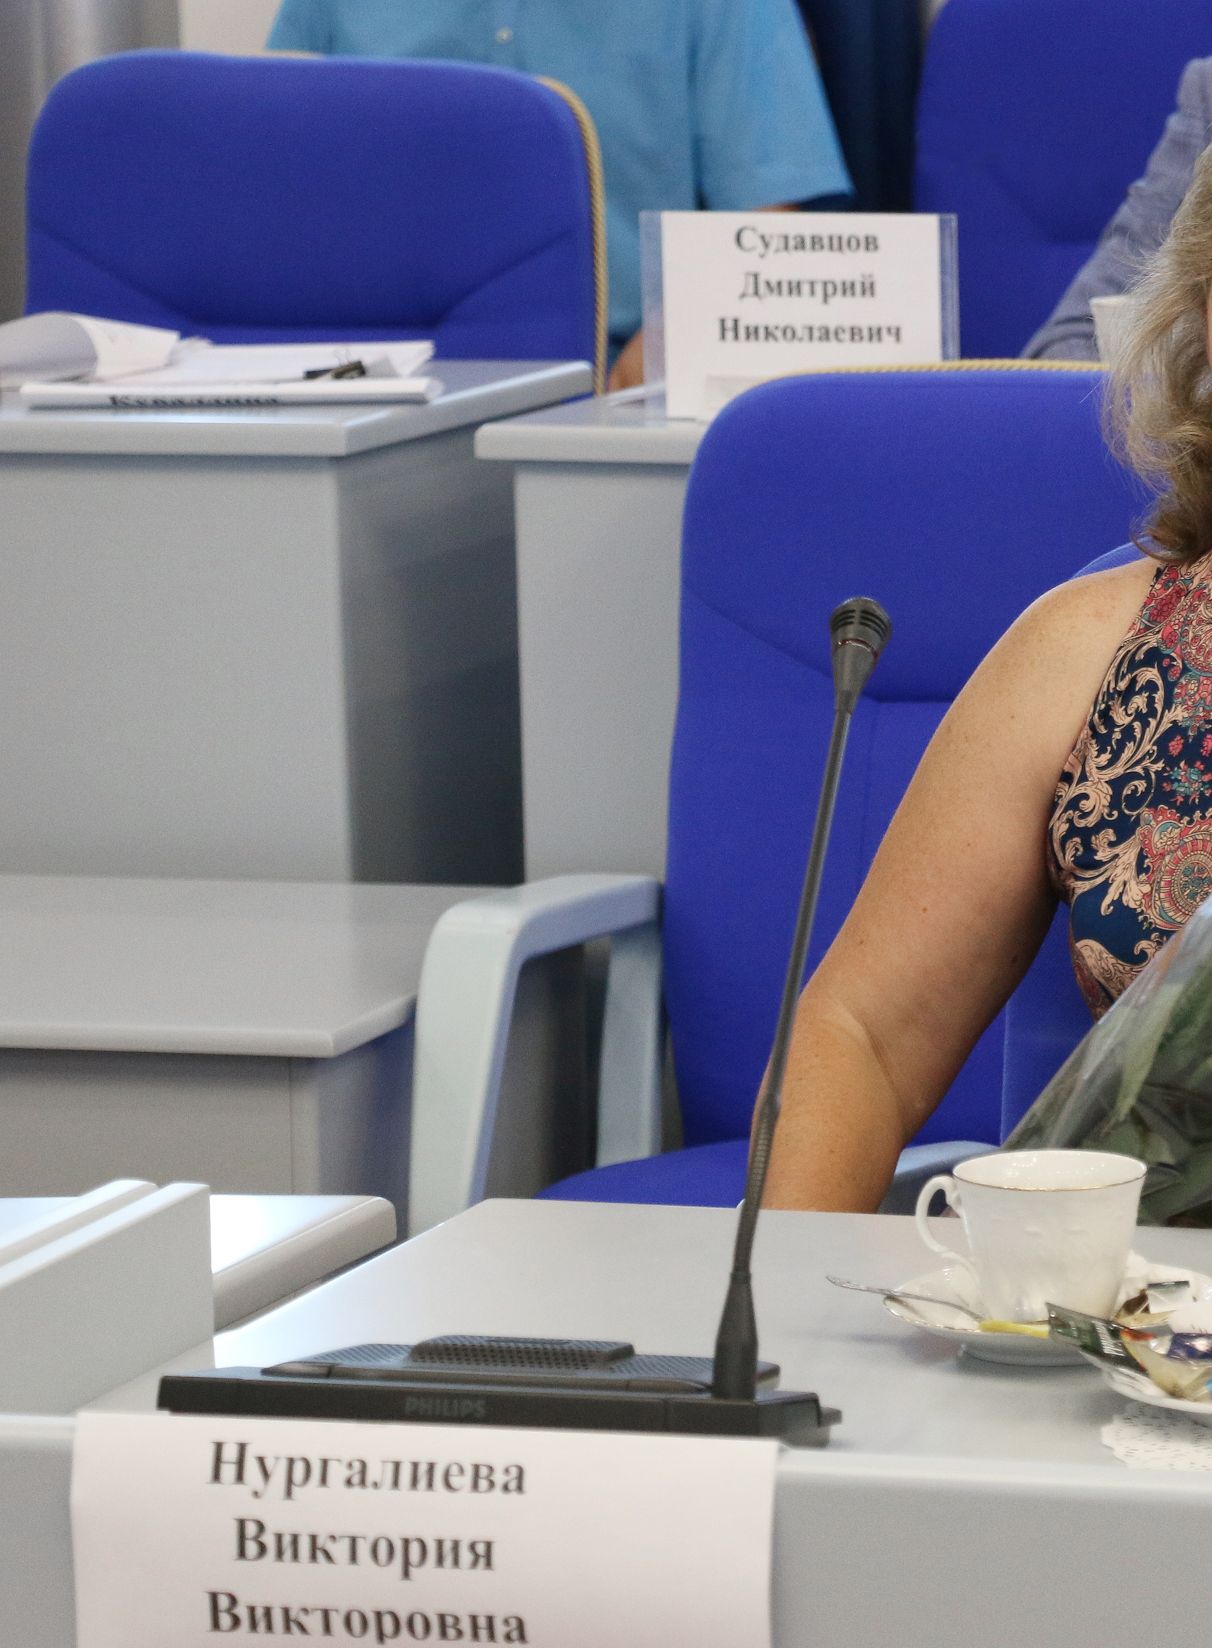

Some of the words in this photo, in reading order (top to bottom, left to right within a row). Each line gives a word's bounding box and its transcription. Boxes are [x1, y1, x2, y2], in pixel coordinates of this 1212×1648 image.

[735, 226, 879, 258] Судавцов
[739, 272, 876, 304] Дмитрий
[718, 317, 903, 344] Николаевич
[206, 1441, 527, 1500] Нургалиева
[232, 1517, 496, 1581] Виктория
[206, 1591, 530, 1645] Викторовна
